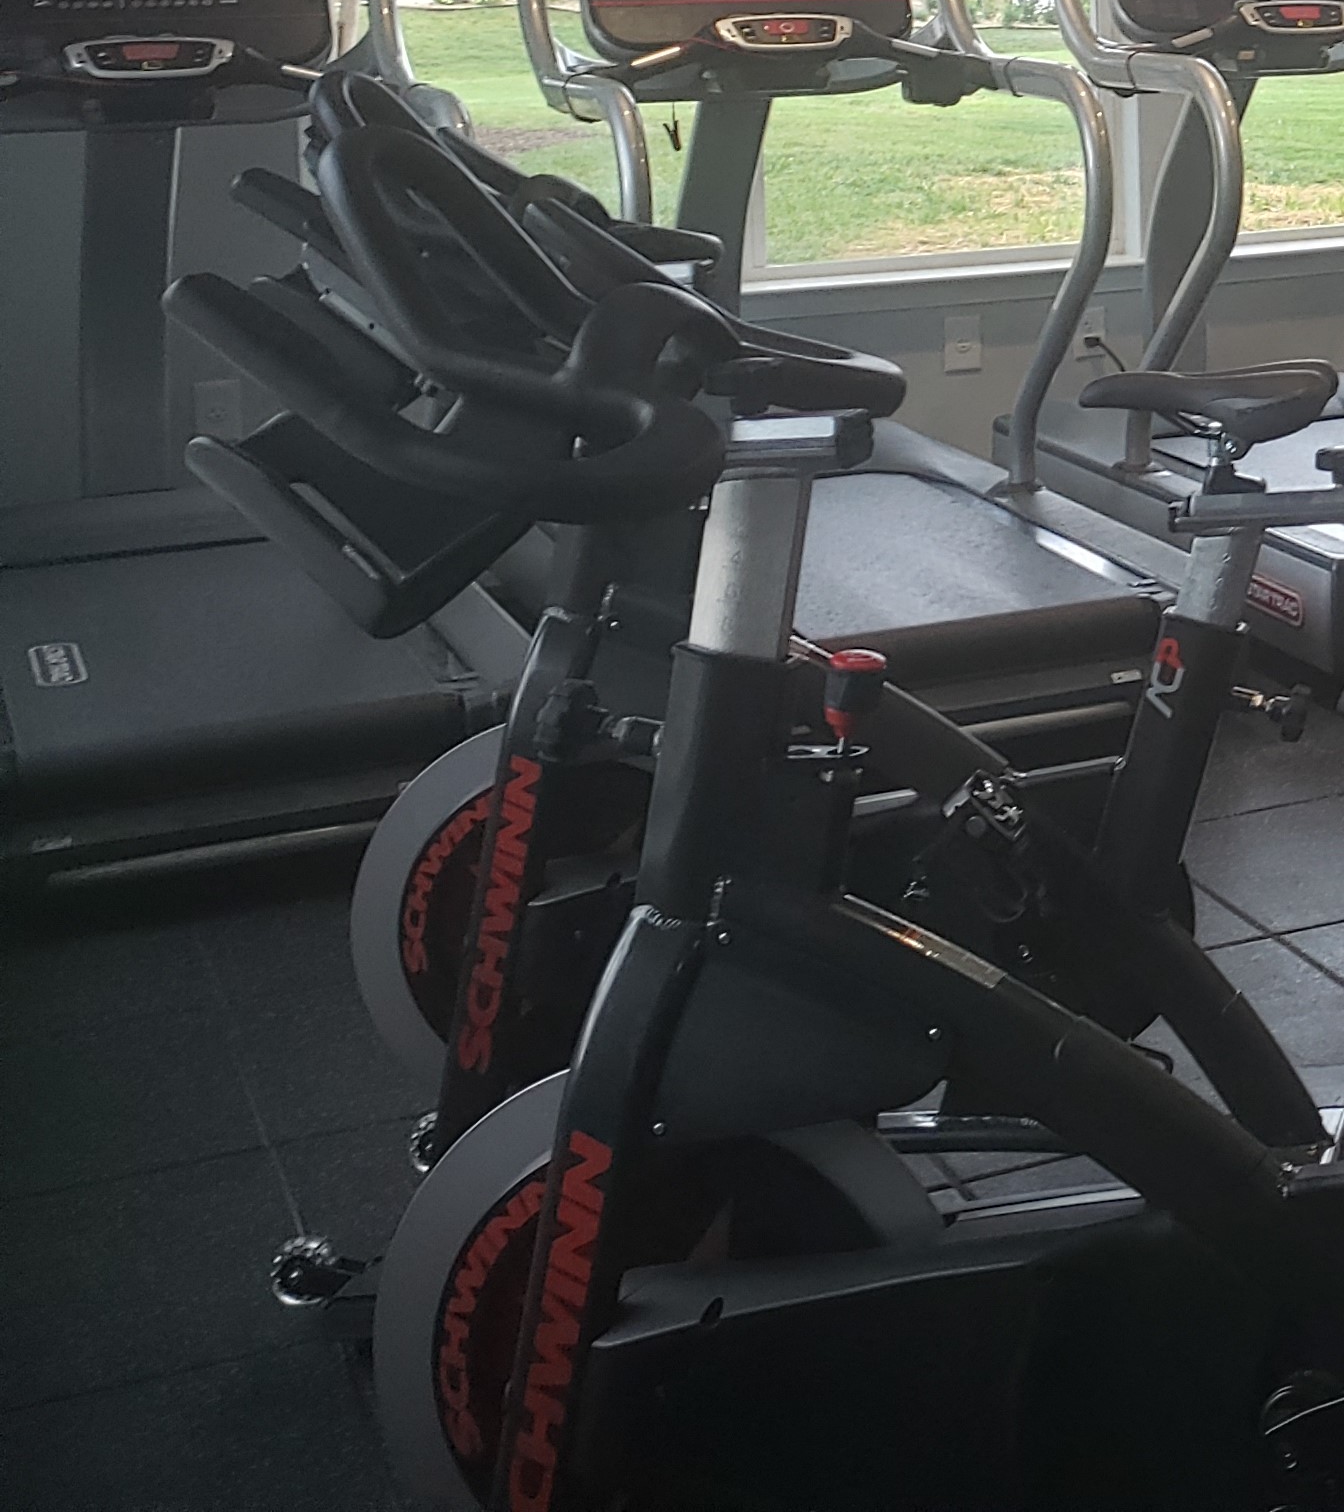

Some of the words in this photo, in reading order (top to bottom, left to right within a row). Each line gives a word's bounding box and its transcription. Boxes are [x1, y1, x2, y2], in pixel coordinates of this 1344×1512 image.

[402, 790, 493, 975] SCHWIN
[457, 754, 543, 1075] SCHWINN
[509, 1129, 613, 1512] CHWINN
